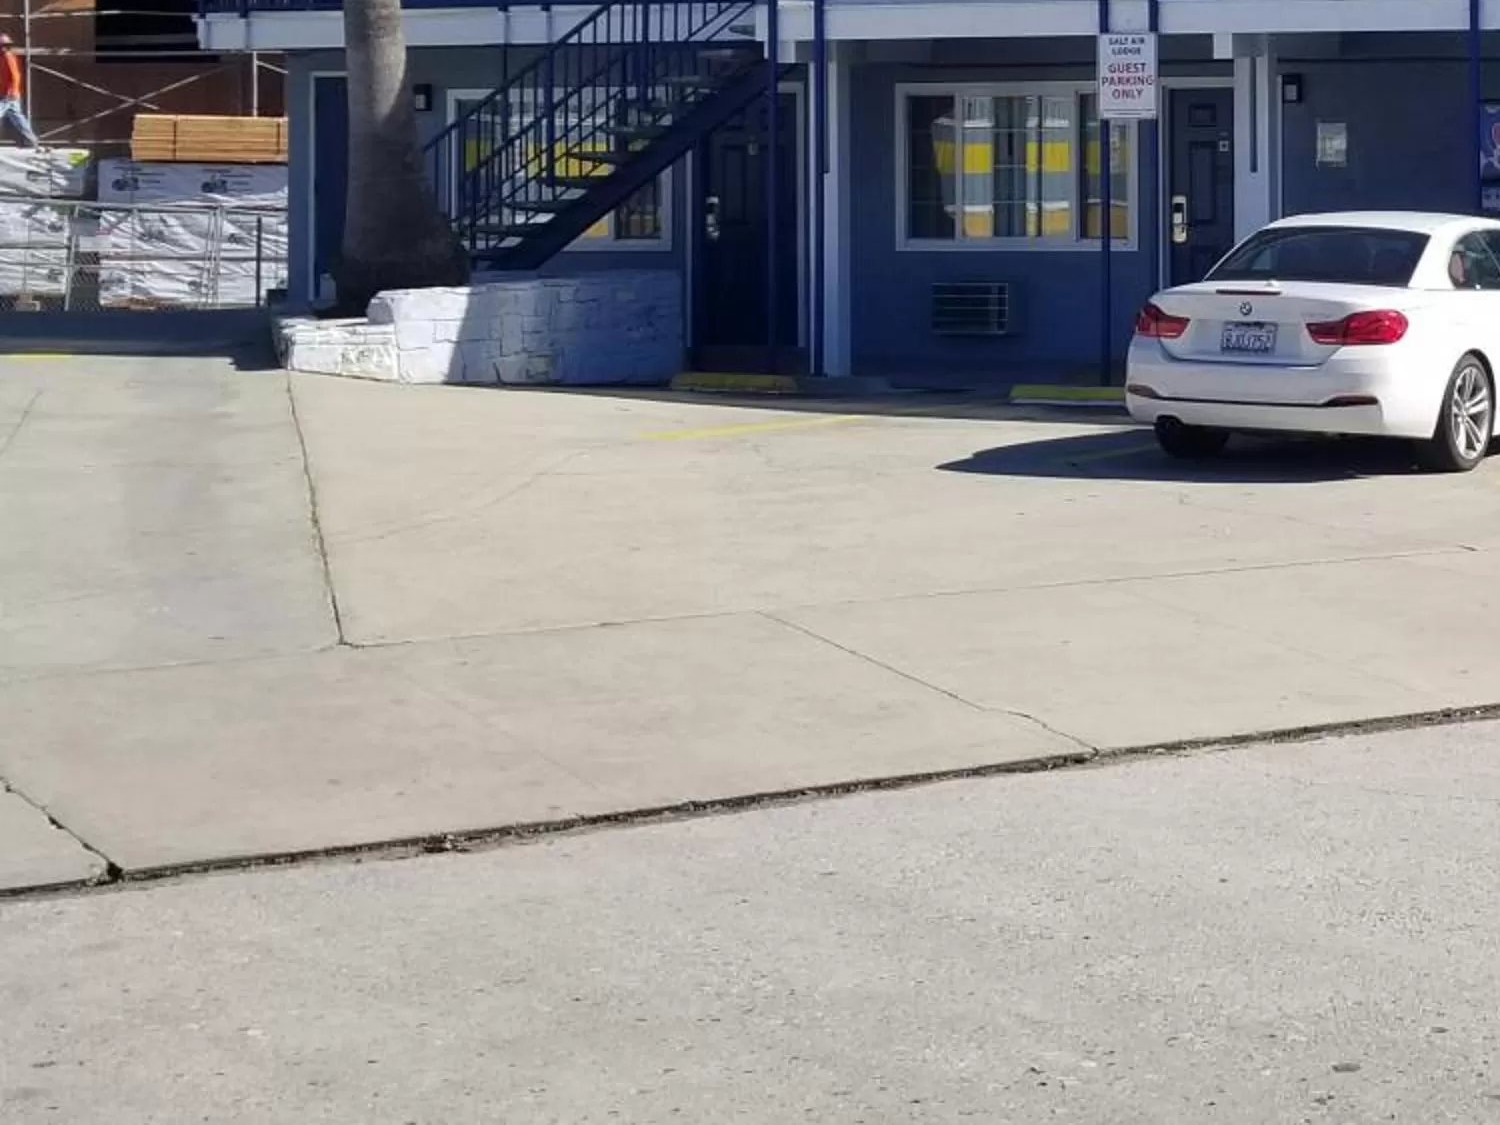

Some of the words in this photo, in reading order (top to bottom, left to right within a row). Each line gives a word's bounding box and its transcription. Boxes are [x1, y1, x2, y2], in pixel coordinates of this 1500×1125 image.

[1107, 62, 1147, 74] GUEST
[1101, 76, 1154, 87] PARKING
[1111, 88, 1144, 100] ONLY
